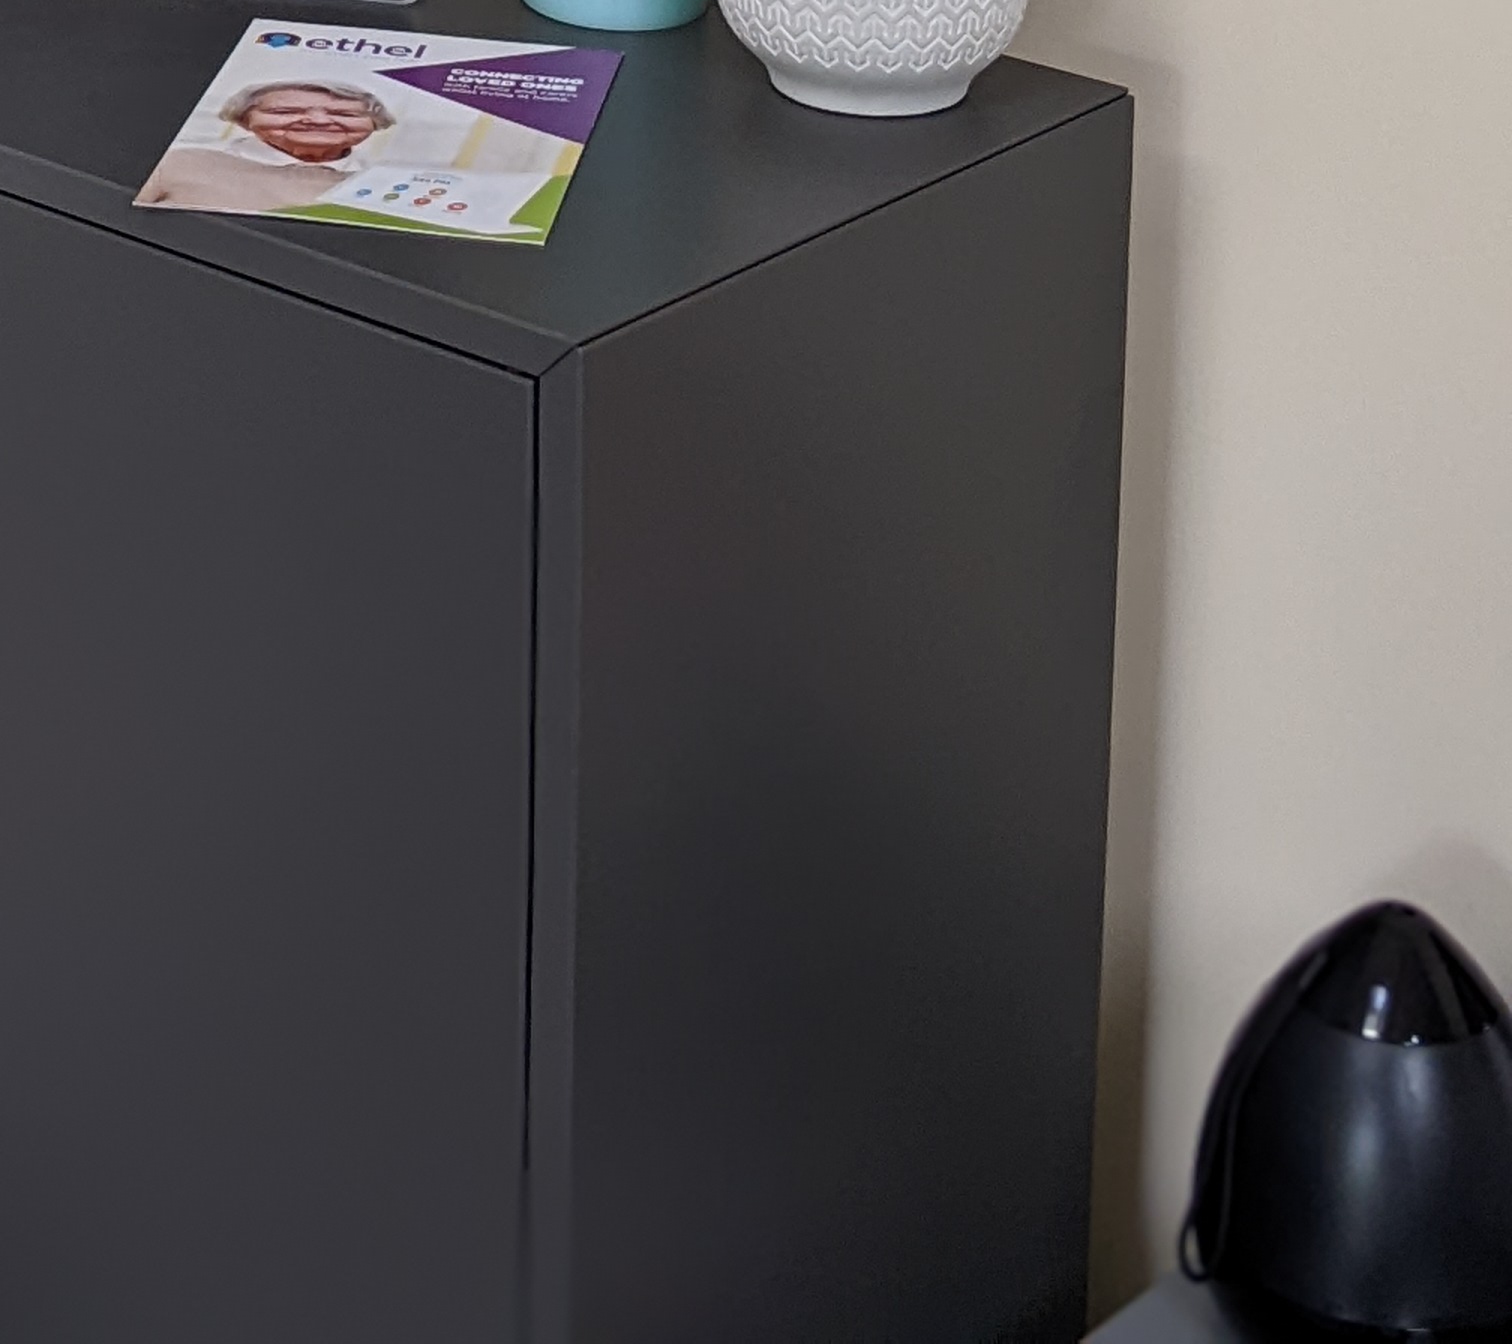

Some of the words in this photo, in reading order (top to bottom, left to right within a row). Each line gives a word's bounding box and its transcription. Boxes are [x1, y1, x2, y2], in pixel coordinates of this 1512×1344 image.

[305, 37, 428, 59] ethel
[446, 74, 517, 87] LOVED
[520, 80, 578, 92] ONES
[450, 68, 585, 85] CONNECTING
